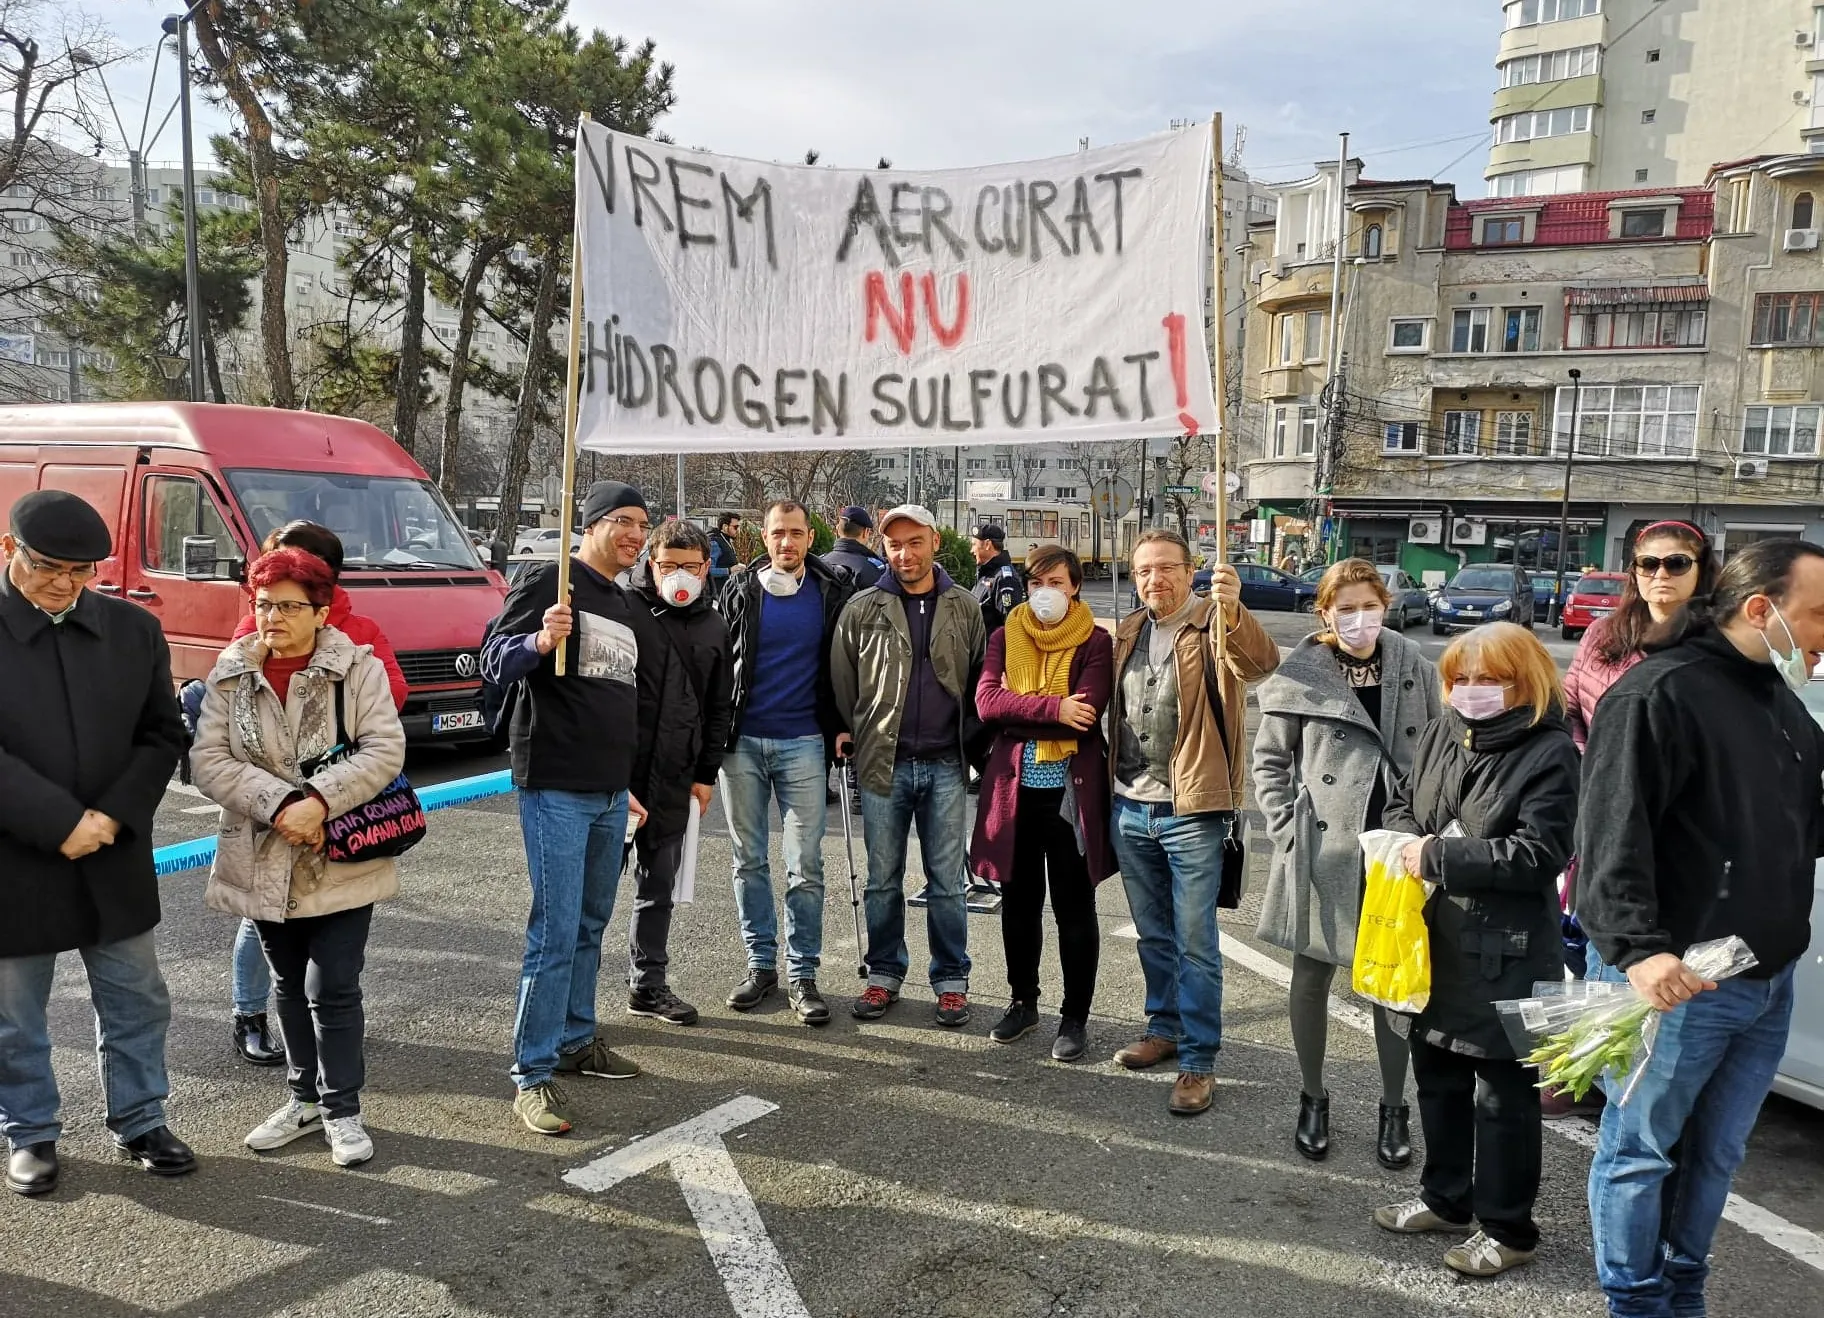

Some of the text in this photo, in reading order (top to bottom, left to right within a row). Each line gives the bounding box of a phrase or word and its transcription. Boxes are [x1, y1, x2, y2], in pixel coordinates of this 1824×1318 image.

[579, 124, 1143, 269] VREM AER CURAT
[864, 270, 969, 355] NU
